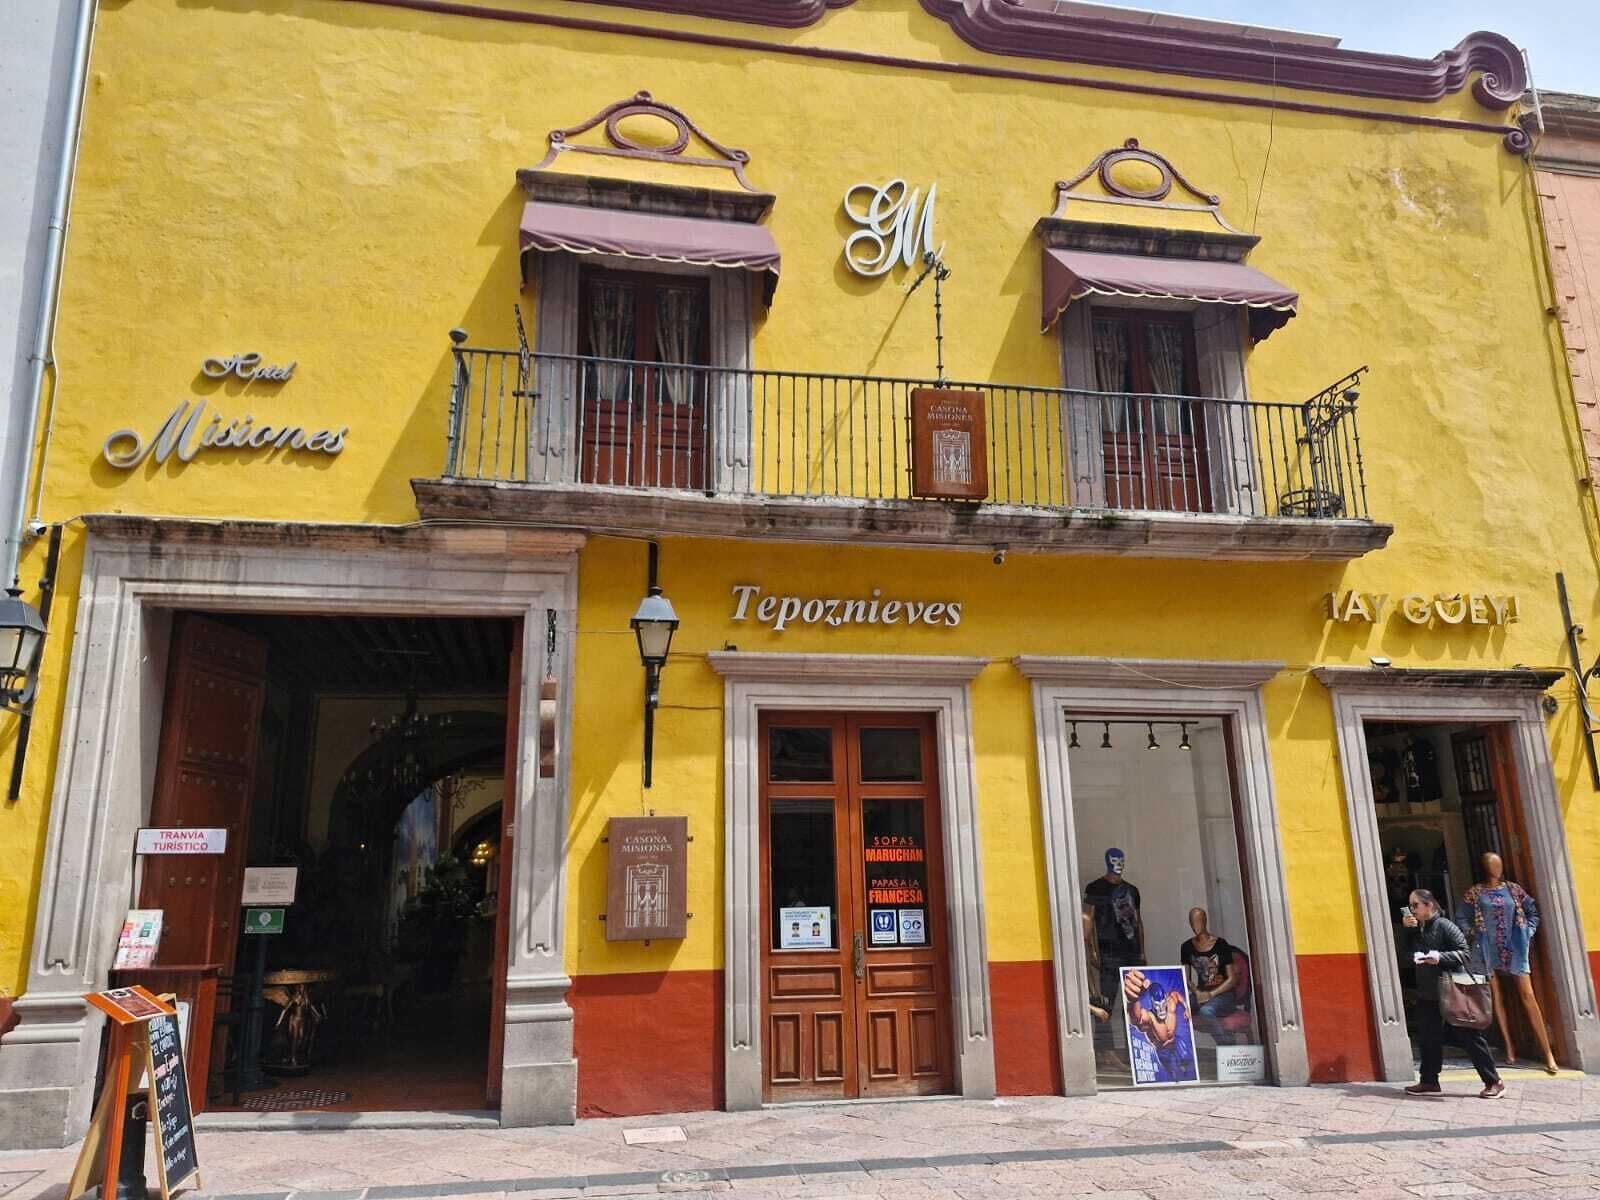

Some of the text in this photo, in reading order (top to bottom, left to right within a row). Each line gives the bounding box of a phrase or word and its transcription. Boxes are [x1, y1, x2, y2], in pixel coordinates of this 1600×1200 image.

[202, 352, 297, 380] Hotel
[930, 405, 968, 414] CASONA
[927, 412, 973, 422] MISIONES
[103, 399, 348, 468] Misiones
[731, 584, 963, 631] Tepoznieves
[625, 835, 668, 844] CASONA
[873, 836, 914, 845] SOPAS
[153, 840, 209, 850] TURÍSTICO
[622, 844, 673, 853] MISIONES
[866, 848, 923, 862] MARUCHAN
[872, 879, 898, 887] PAPAS
[869, 889, 924, 904] FRANCESA
